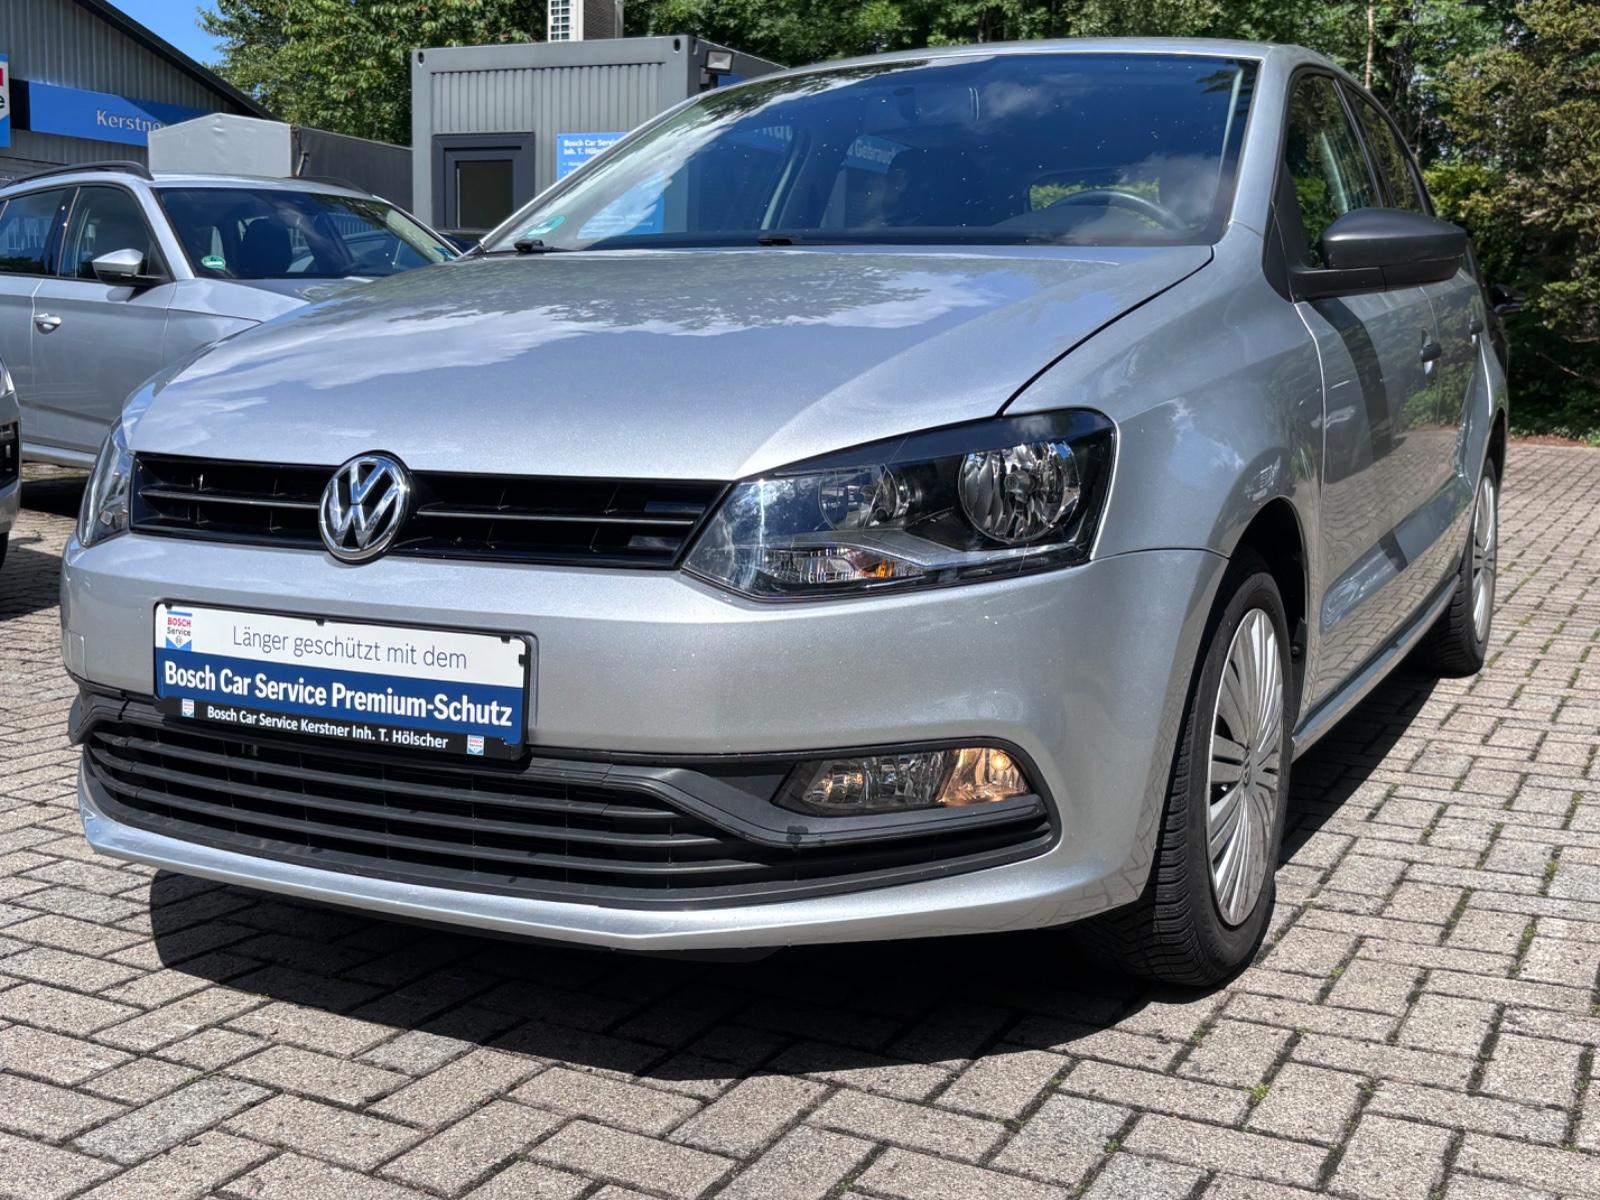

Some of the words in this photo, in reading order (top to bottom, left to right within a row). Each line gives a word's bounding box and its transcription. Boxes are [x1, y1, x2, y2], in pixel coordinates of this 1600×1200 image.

[96, 109, 167, 132] Kerstne
[167, 616, 192, 627] BOSCH
[167, 626, 192, 636] Service
[233, 625, 289, 653] Länger
[293, 633, 381, 661] geschützt
[387, 643, 417, 665] mit
[423, 645, 467, 669] dem
[164, 660, 216, 691] Bosch
[220, 668, 252, 696] Car
[255, 673, 327, 706] Service
[332, 682, 513, 727] Premium-Schutz
[207, 705, 238, 722] Bosch
[239, 710, 257, 725] Car
[259, 713, 298, 731] Service
[300, 718, 350, 737] Kerstner
[352, 725, 376, 741] Inh.
[378, 728, 389, 742] T.
[392, 729, 449, 749] Hölscher
